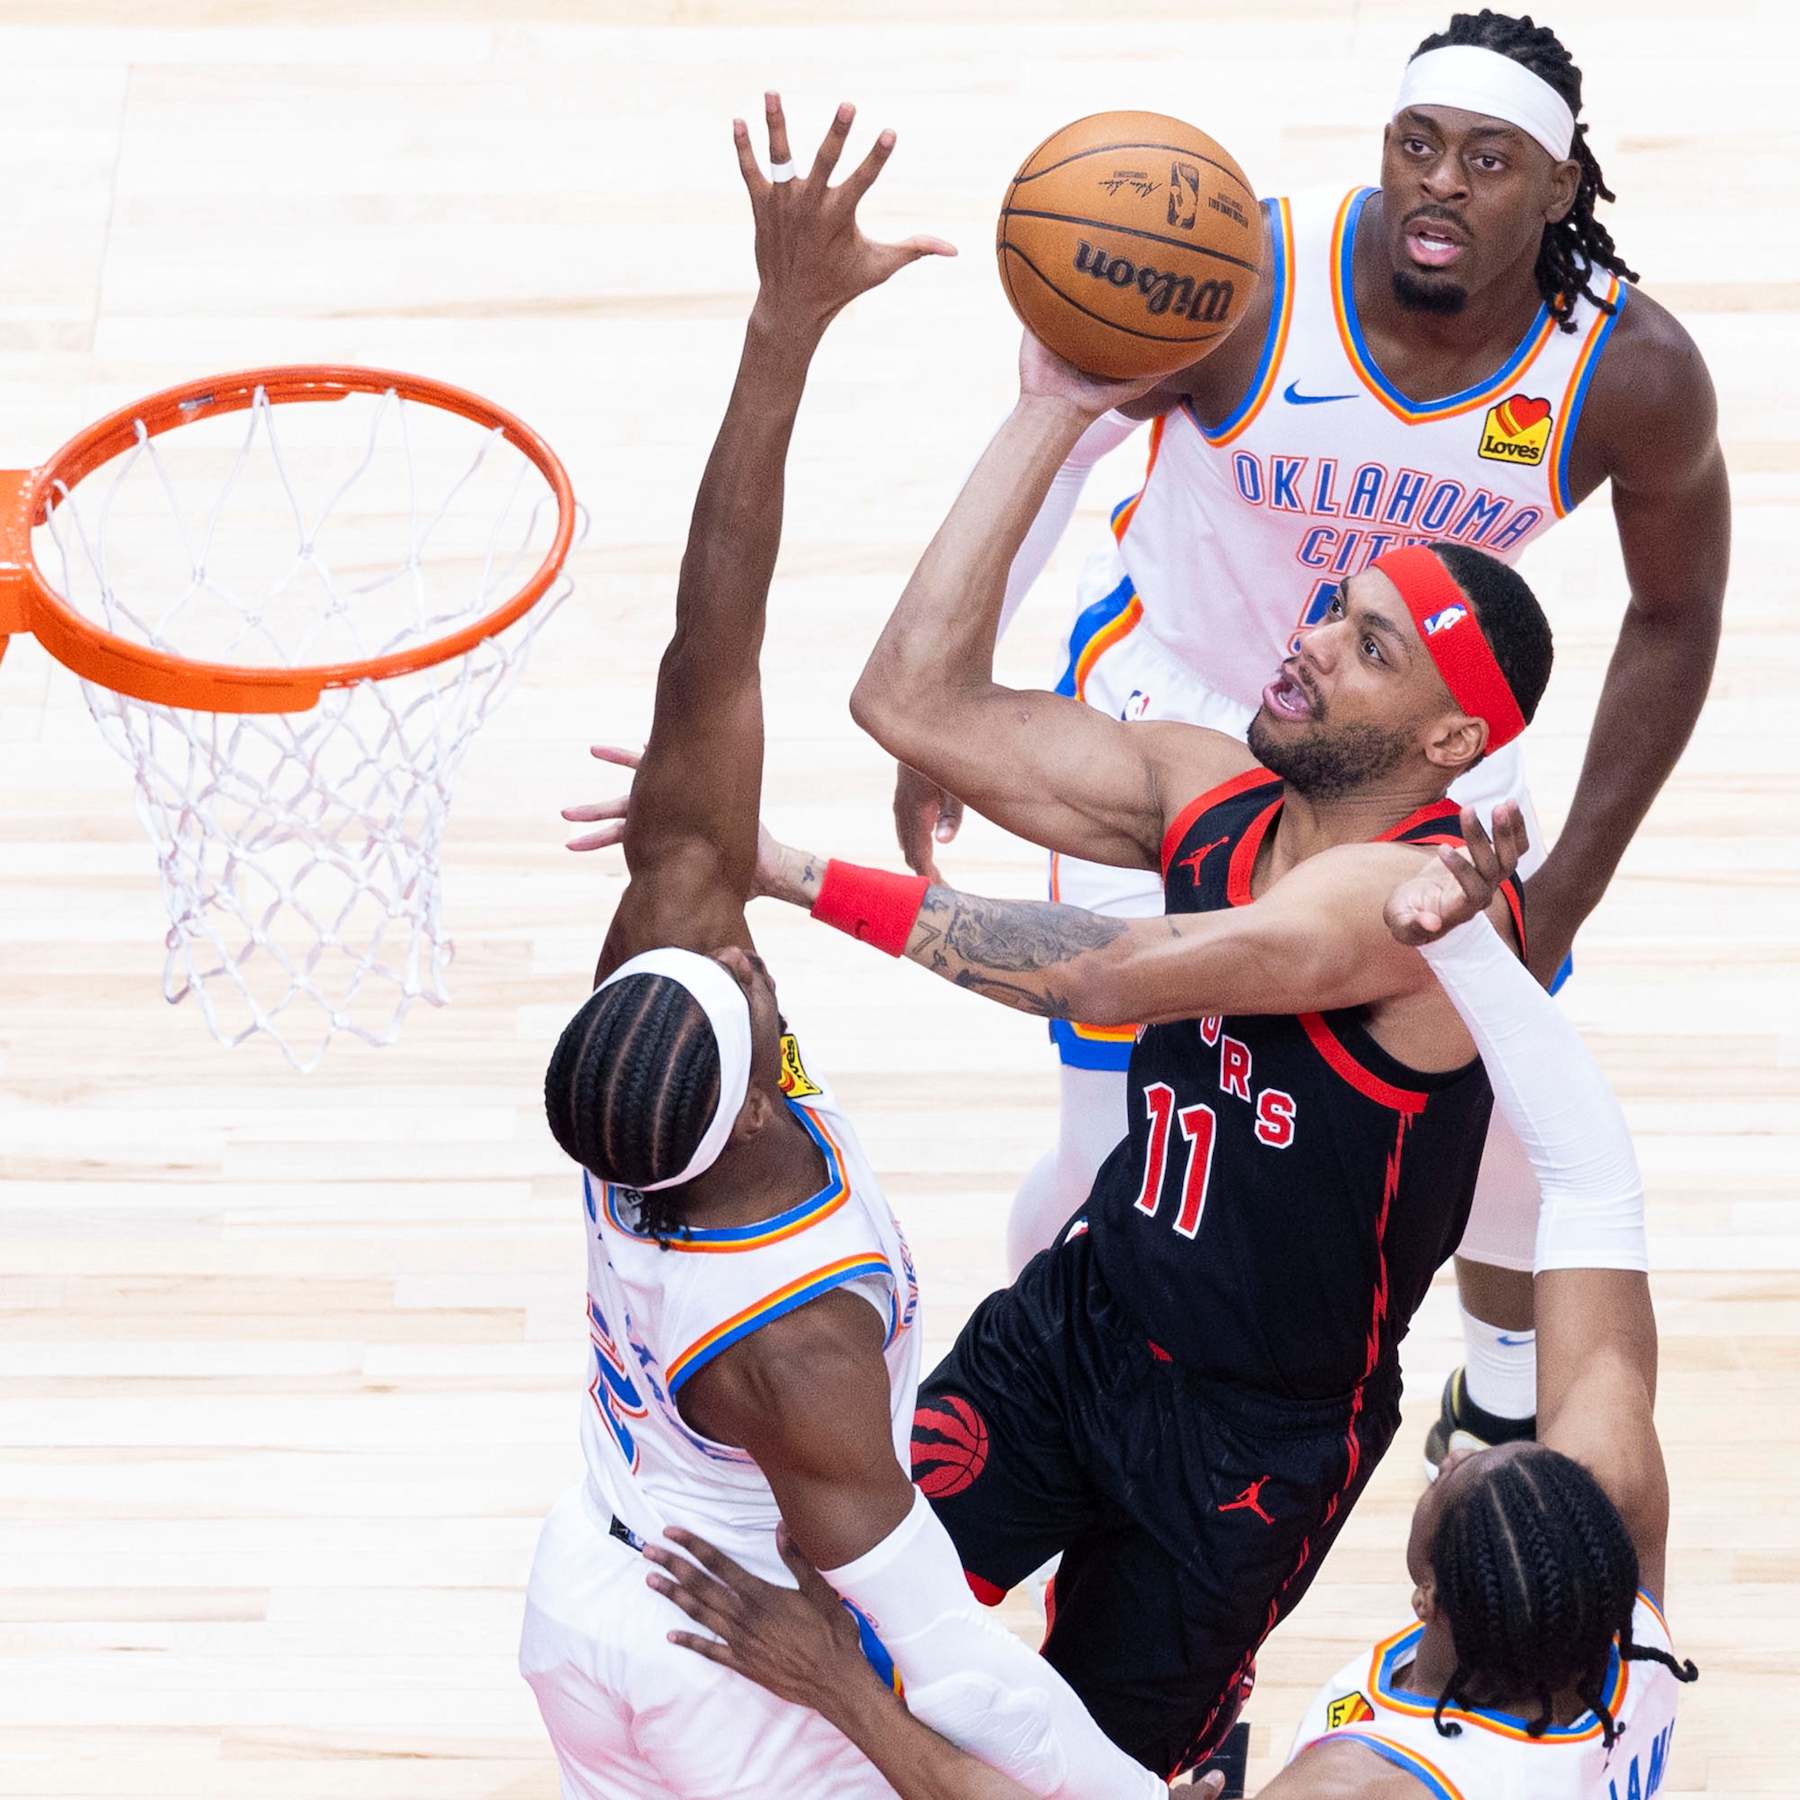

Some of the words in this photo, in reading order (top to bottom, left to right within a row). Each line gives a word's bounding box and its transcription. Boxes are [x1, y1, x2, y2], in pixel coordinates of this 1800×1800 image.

[1073, 240, 1234, 322] Wilson
[1232, 450, 1544, 552] OKLAHOMA
[1297, 525, 1436, 575] CIT
[1134, 1081, 1217, 1241] 11
